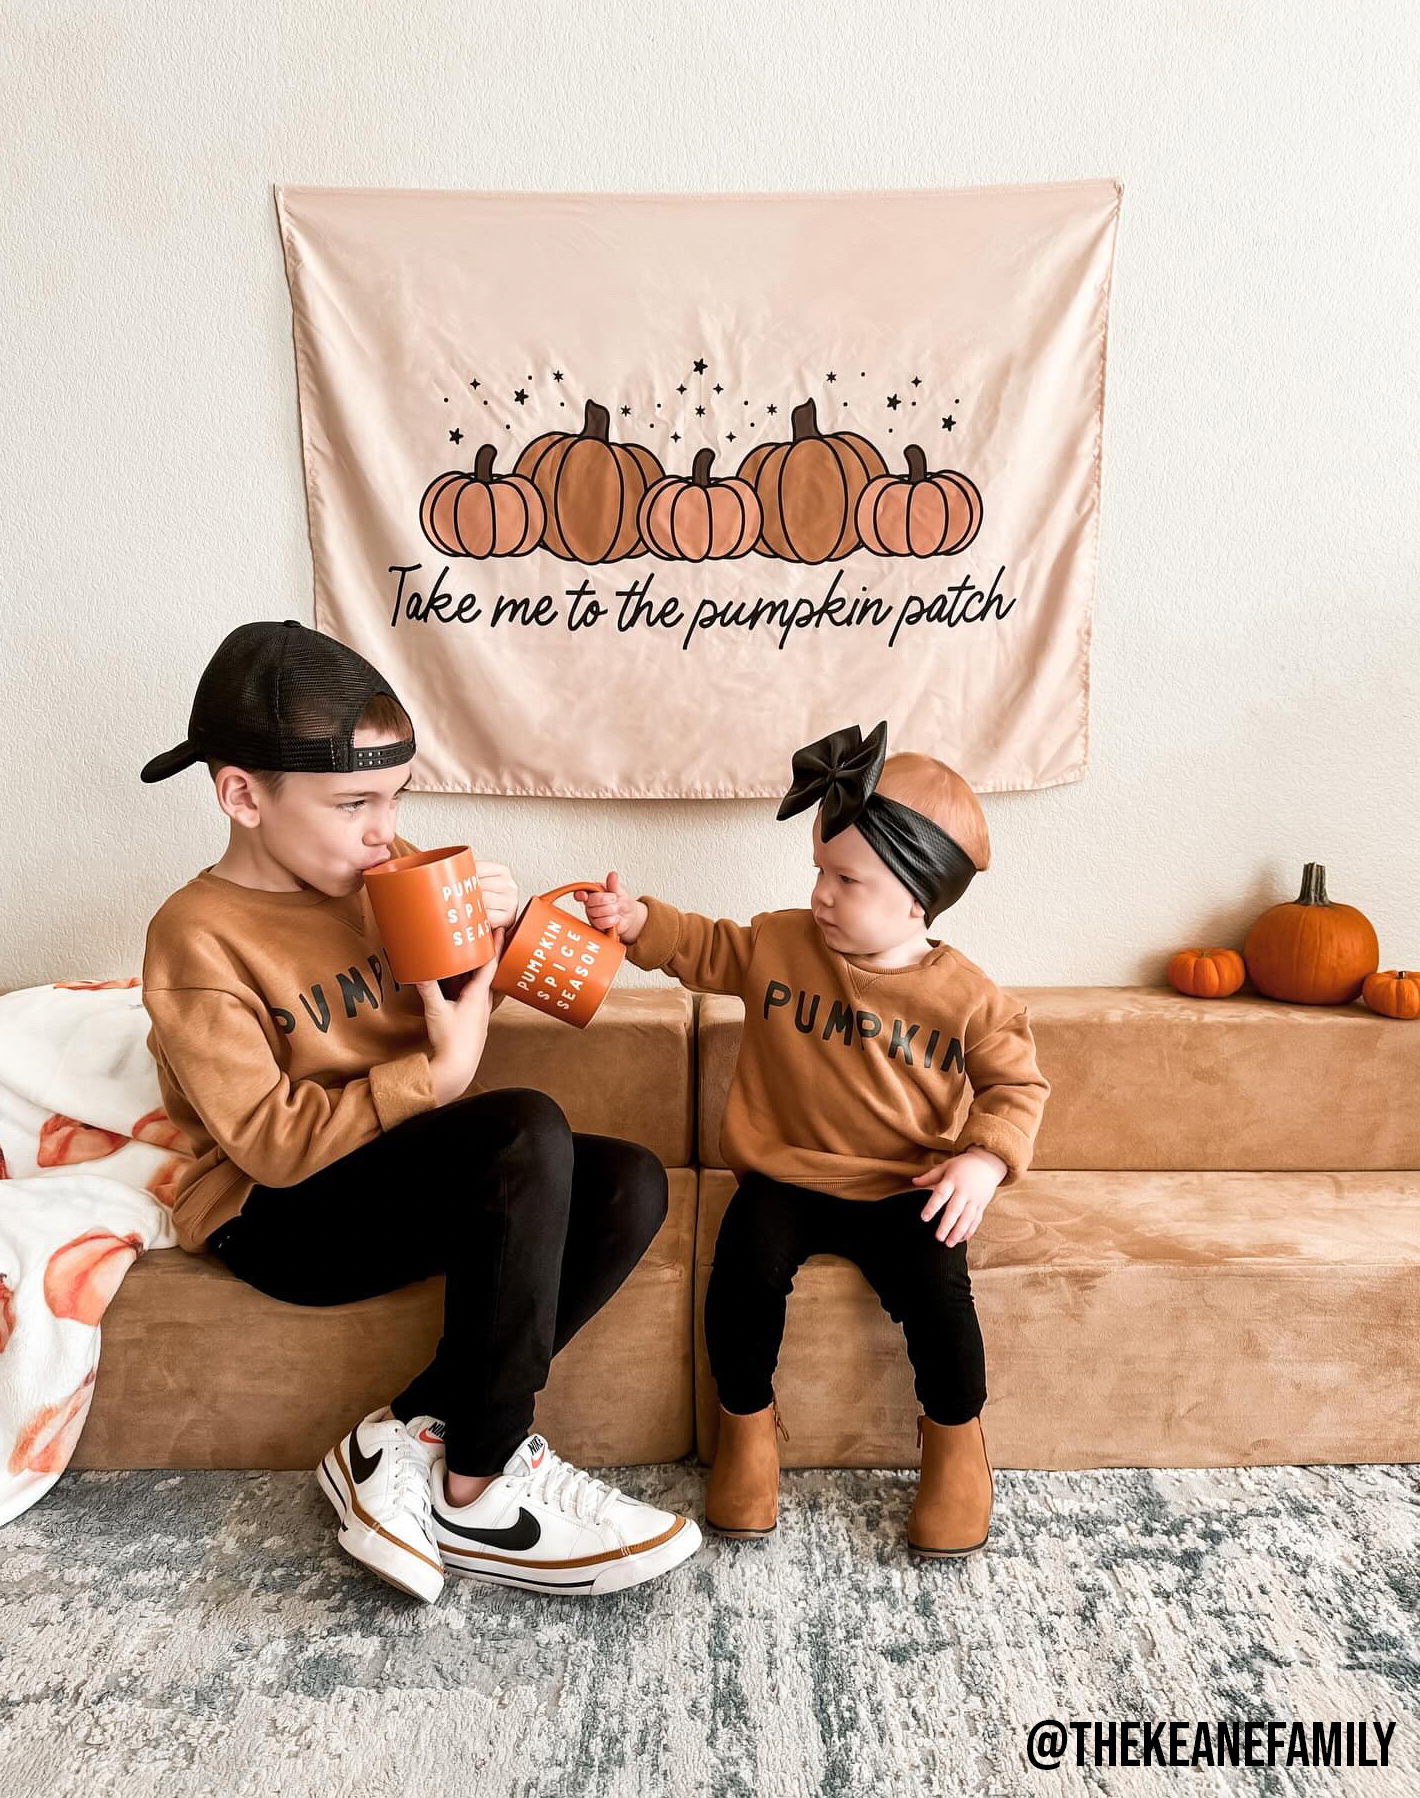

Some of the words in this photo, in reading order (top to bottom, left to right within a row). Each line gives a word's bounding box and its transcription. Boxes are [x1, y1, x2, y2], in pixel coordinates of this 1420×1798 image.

[388, 563, 482, 627] Take
[490, 595, 559, 628] me
[565, 579, 608, 631] to
[615, 572, 685, 632] the
[682, 568, 894, 650] pumpkin
[887, 565, 1017, 648] patch
[442, 875, 479, 902] PUMP
[447, 899, 483, 924] SPI
[452, 919, 491, 946] SEAS
[516, 920, 562, 991] PUMPKIN
[537, 930, 581, 1000] SPICE
[269, 948, 400, 1034] PUMP
[556, 941, 600, 1010] SEASON
[763, 979, 965, 1074] PUMPKIN
[428, 1421, 446, 1438] NIK
[527, 1435, 544, 1456] NIKE
